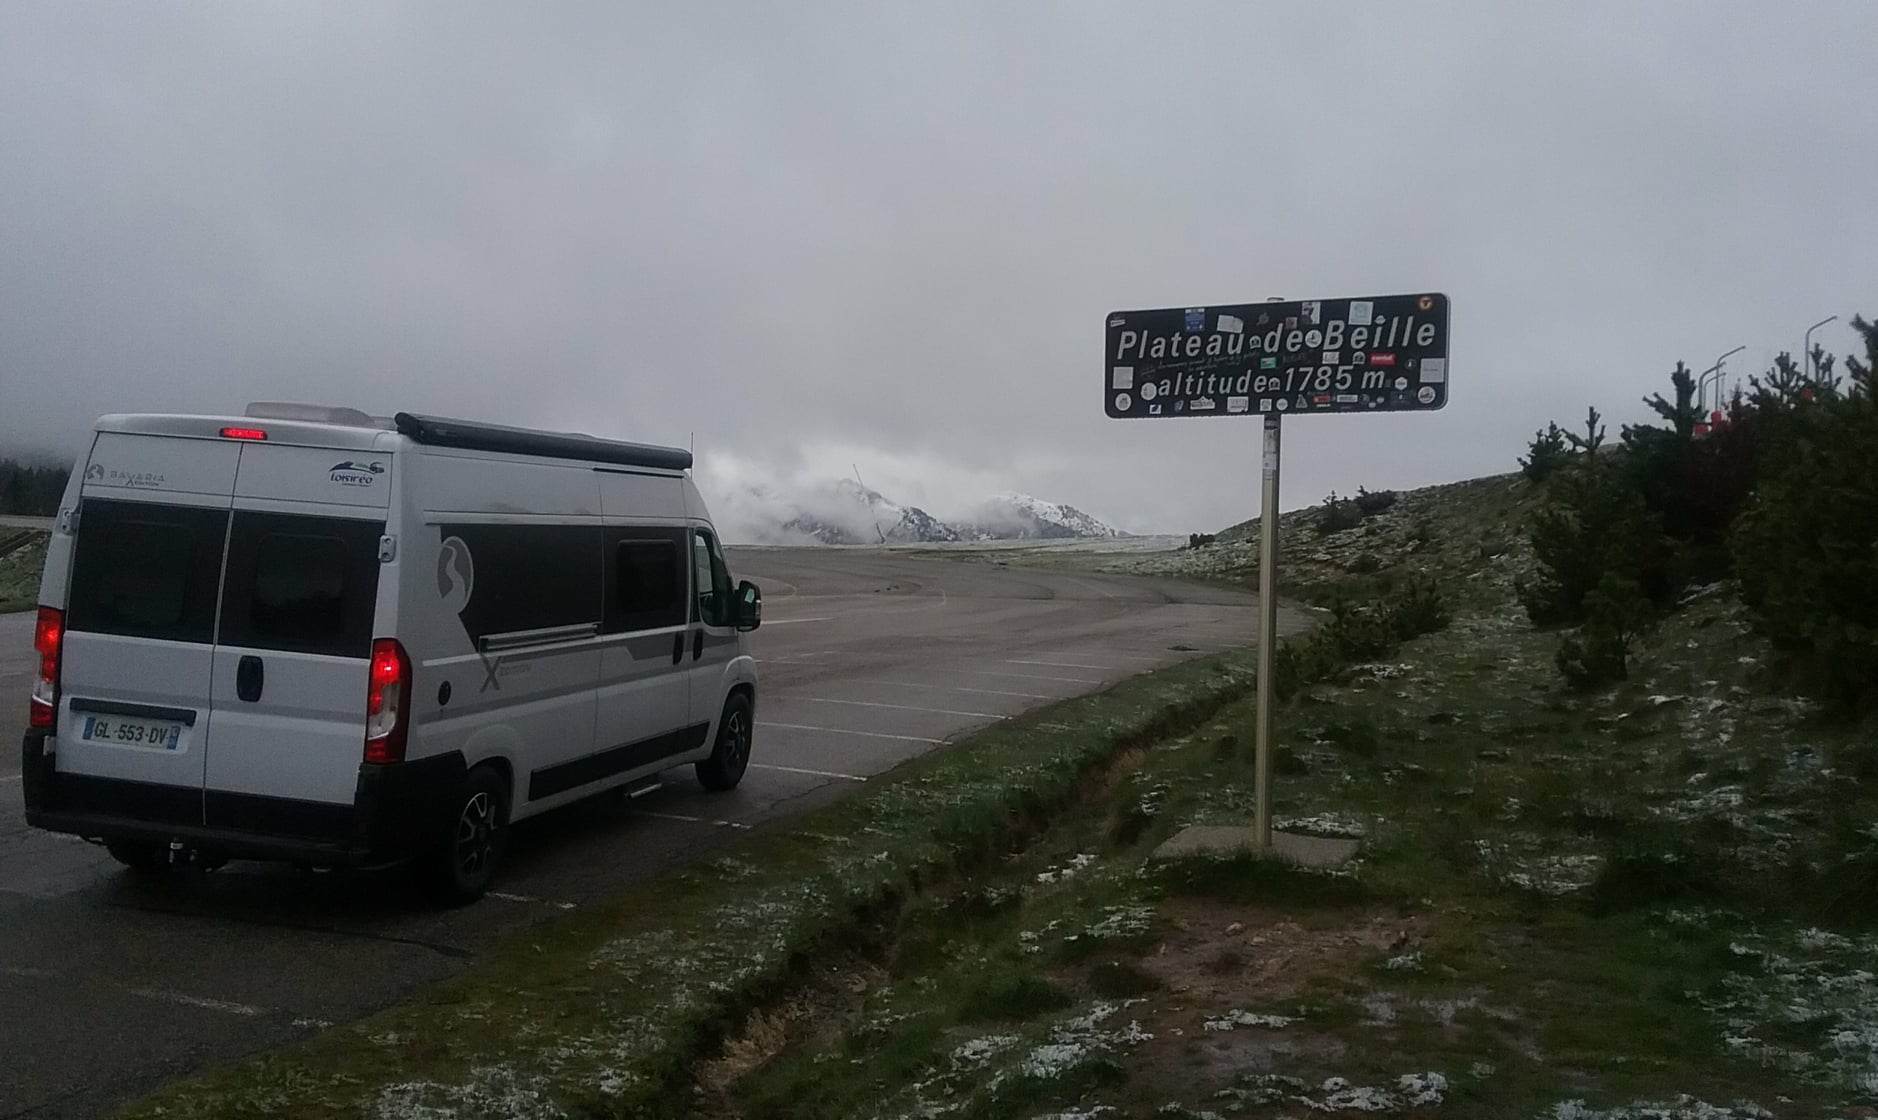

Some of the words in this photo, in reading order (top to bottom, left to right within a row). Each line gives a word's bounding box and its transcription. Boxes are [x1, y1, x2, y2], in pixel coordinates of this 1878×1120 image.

[1117, 330, 1244, 360] Plateau
[1264, 323, 1303, 353] de
[1323, 316, 1435, 350] Beille
[1158, 370, 1266, 396] altitude
[1285, 365, 1353, 392] 1785
[1361, 370, 1385, 389] m
